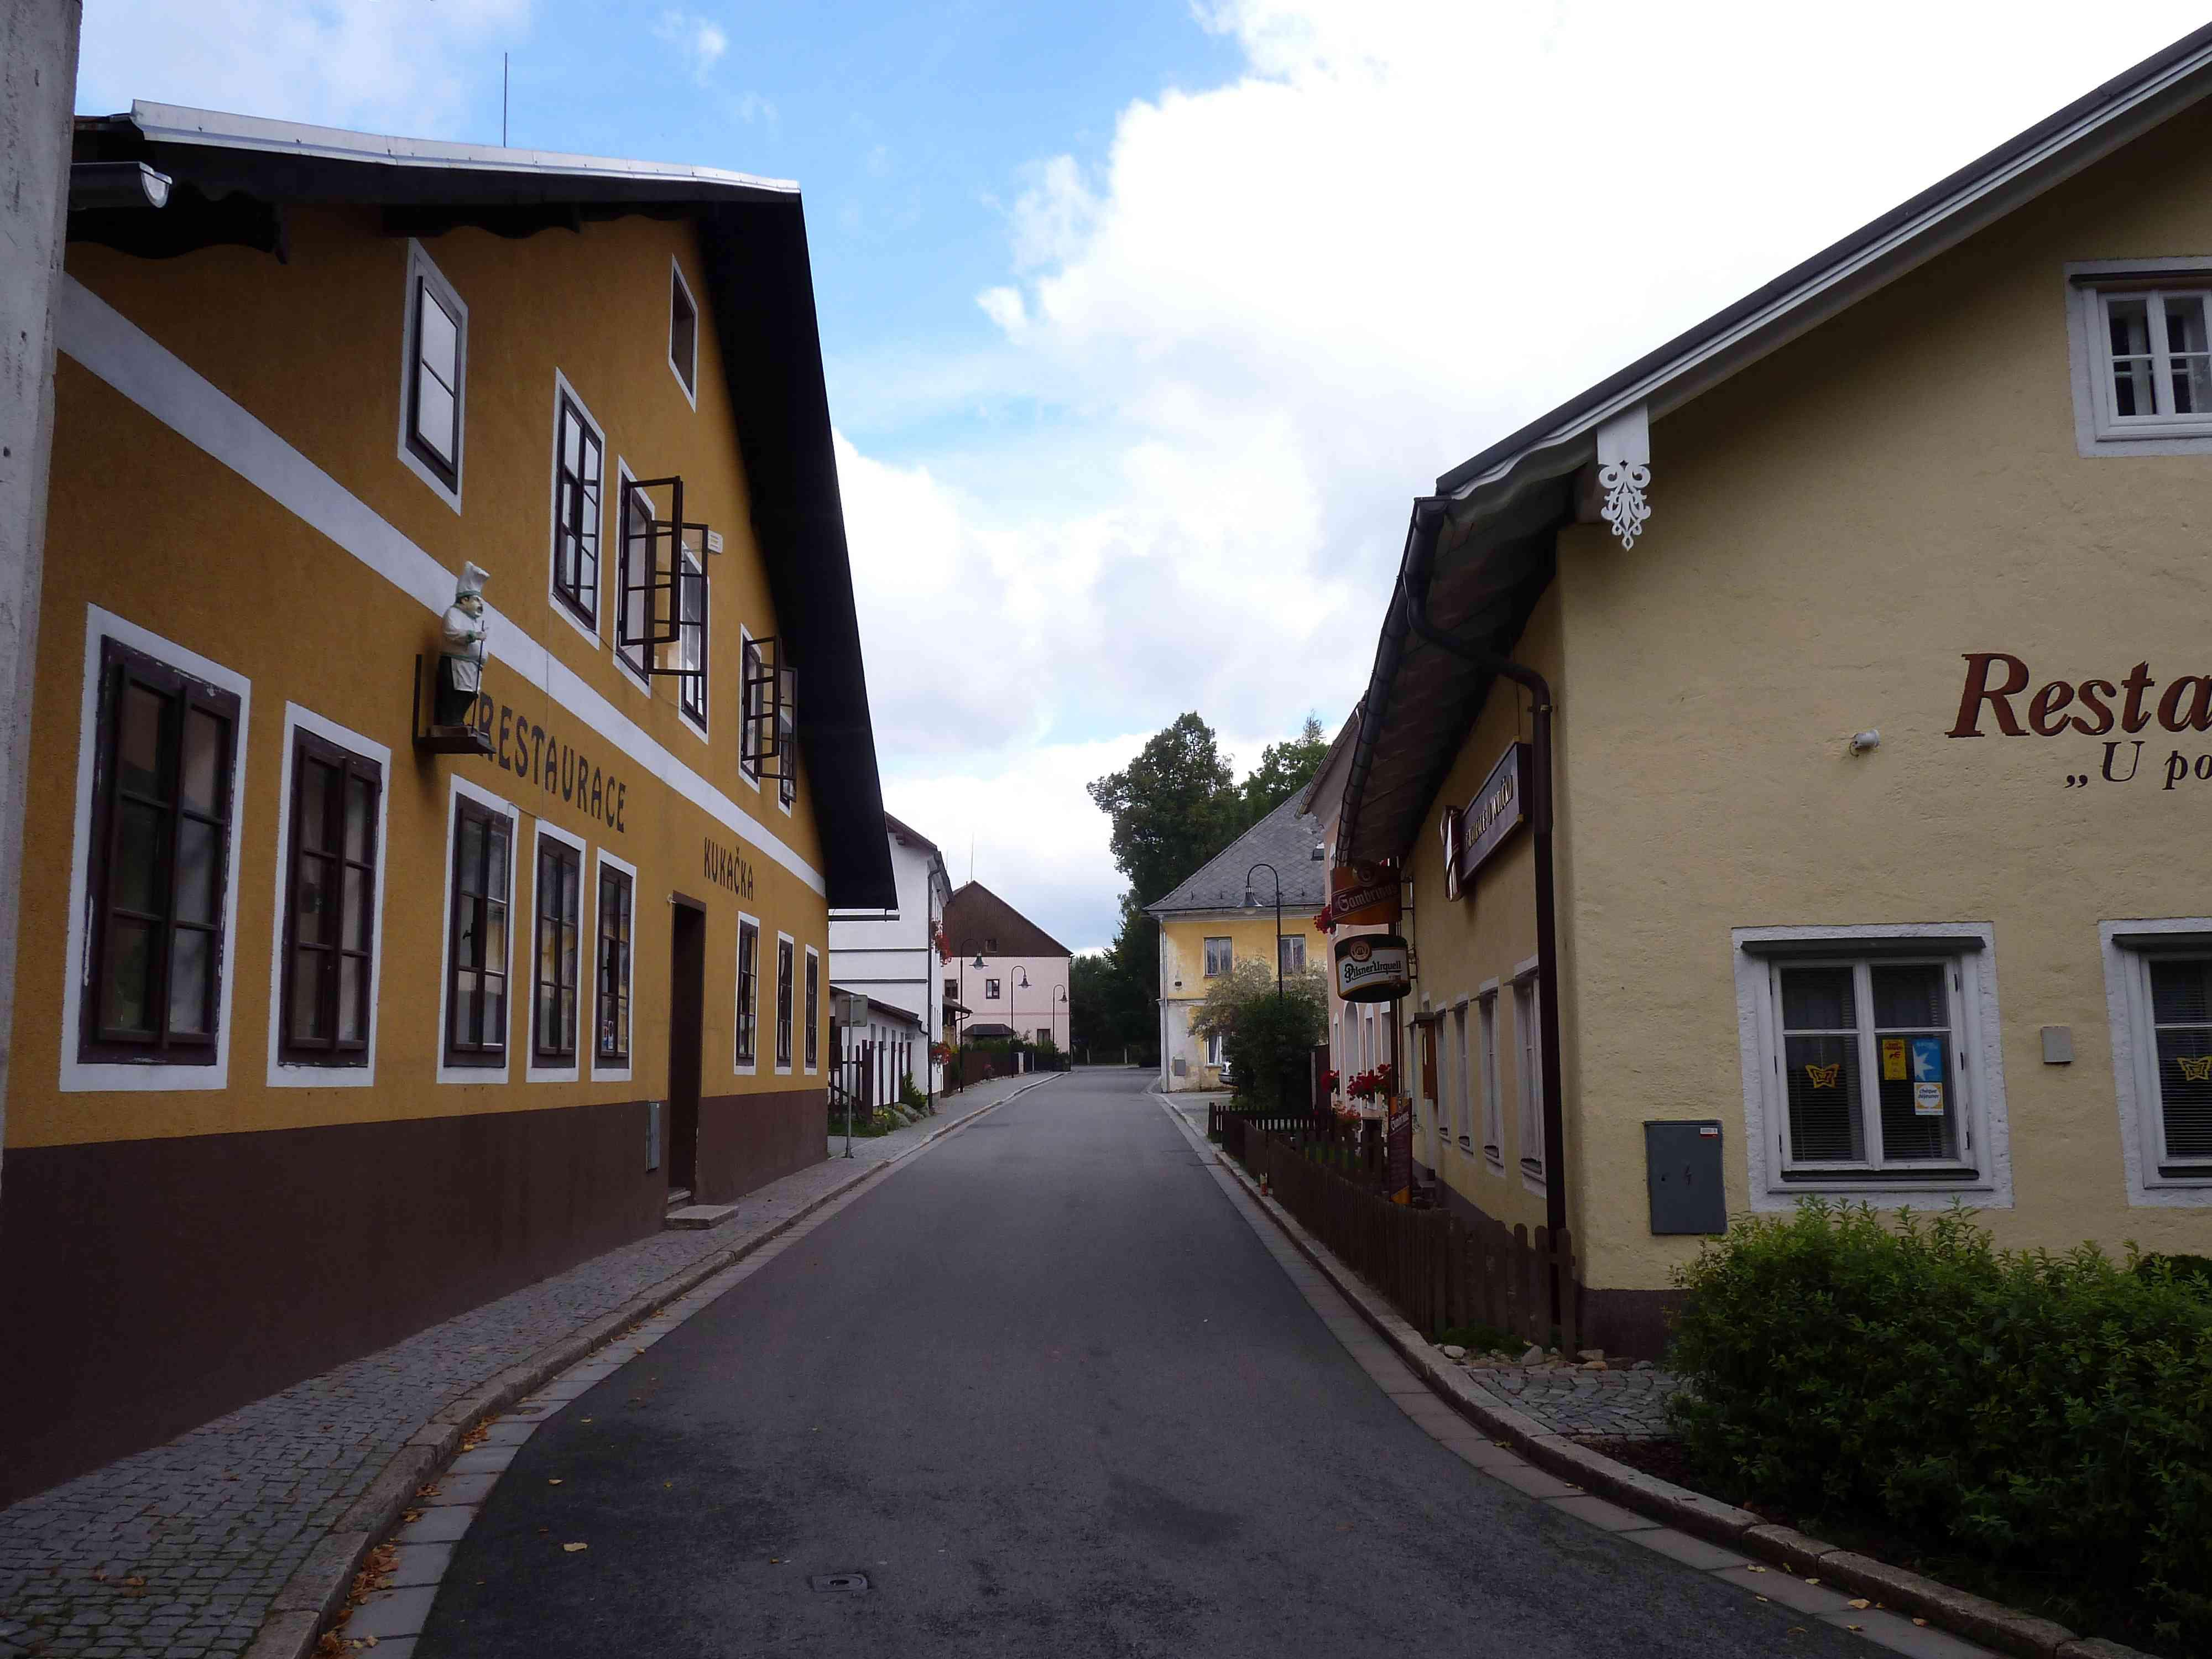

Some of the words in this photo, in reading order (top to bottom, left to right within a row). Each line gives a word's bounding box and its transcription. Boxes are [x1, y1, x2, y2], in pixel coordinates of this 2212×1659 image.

[1944, 653, 2212, 738] Resta
[479, 692, 625, 833] RESTAURACE
[704, 837, 753, 901] KUKAČKA
[1344, 962, 1373, 983] Pilsner
[1373, 961, 1401, 976] Urquell
